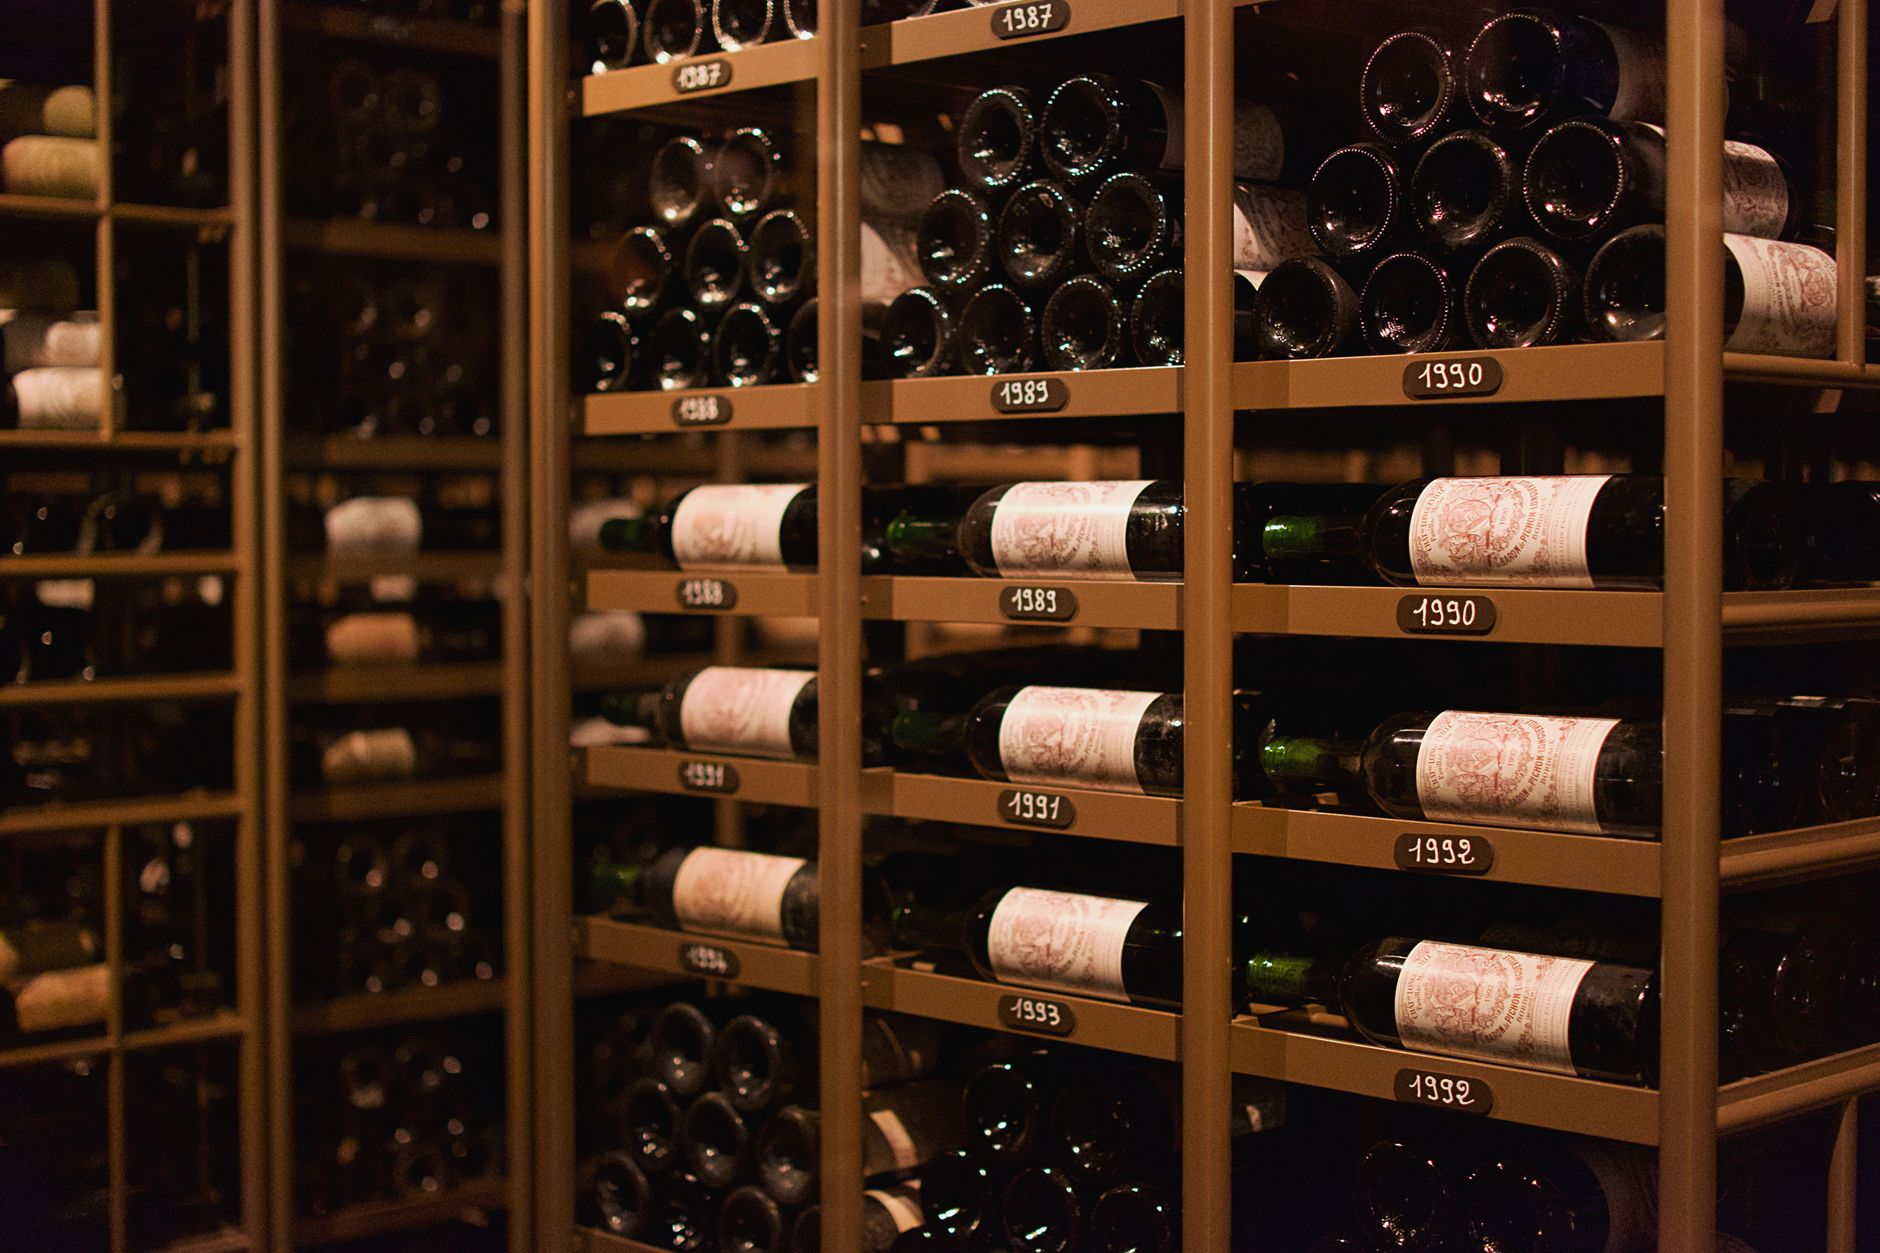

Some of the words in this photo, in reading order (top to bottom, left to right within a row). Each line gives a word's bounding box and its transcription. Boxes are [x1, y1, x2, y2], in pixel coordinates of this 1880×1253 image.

[1002, 3, 1052, 31] 1987
[677, 62, 721, 88] 1987
[1419, 364, 1482, 388] 1990
[1000, 381, 1048, 404] 1989
[1500, 545, 1521, 566] BARON
[1519, 511, 1537, 542] PICHON
[1012, 589, 1056, 612] 1989
[1413, 599, 1475, 626] 1990
[1528, 755, 1544, 786] PICHON
[1009, 792, 1059, 819] 1991
[1409, 838, 1474, 864] 1992
[1011, 998, 1060, 1025] 1993
[1505, 993, 1522, 1024] PICHON
[1409, 1075, 1474, 1104] 1992
